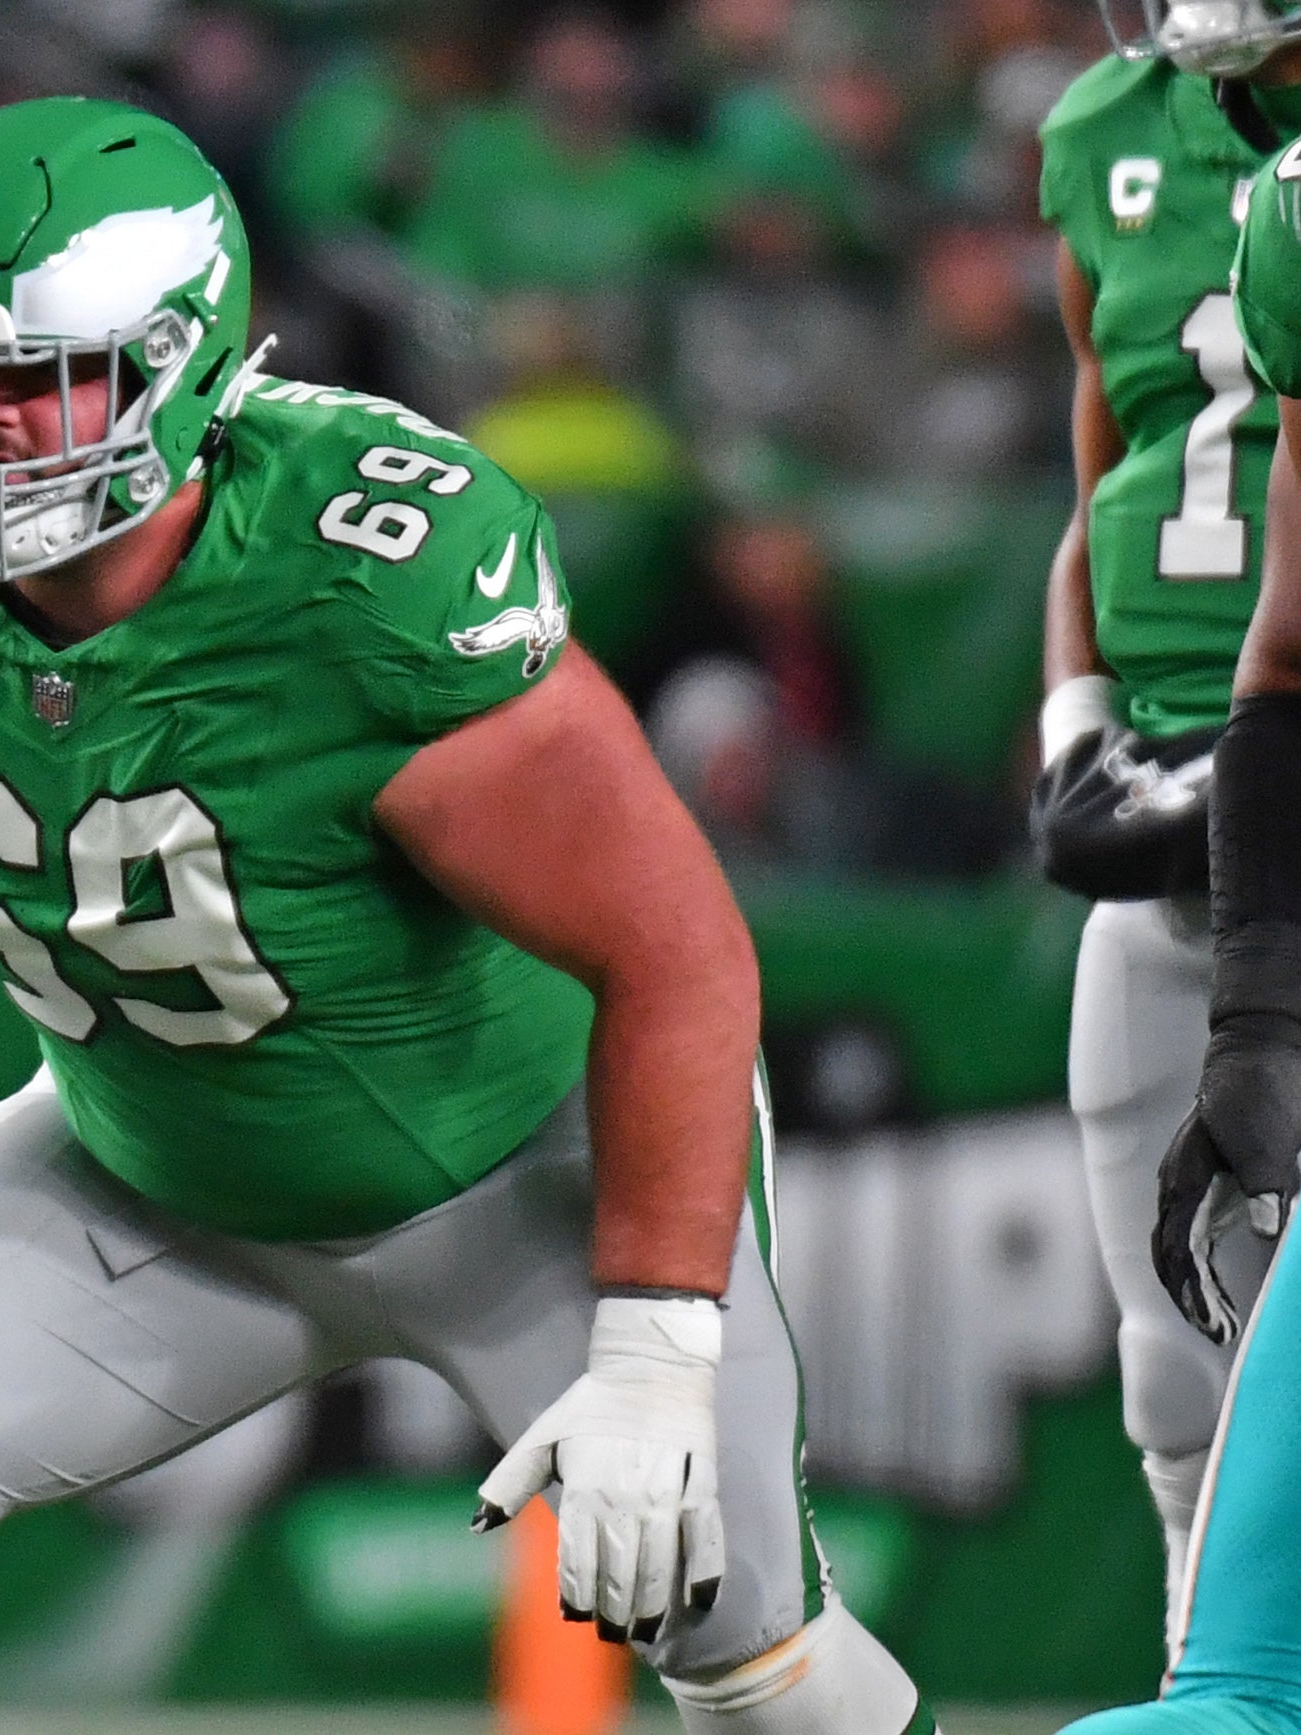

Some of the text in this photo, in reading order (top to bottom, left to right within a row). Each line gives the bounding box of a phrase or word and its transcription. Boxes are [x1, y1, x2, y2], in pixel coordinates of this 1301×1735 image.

[1109, 157, 1162, 218] C
[1157, 288, 1256, 577] 1
[315, 445, 474, 565] 69
